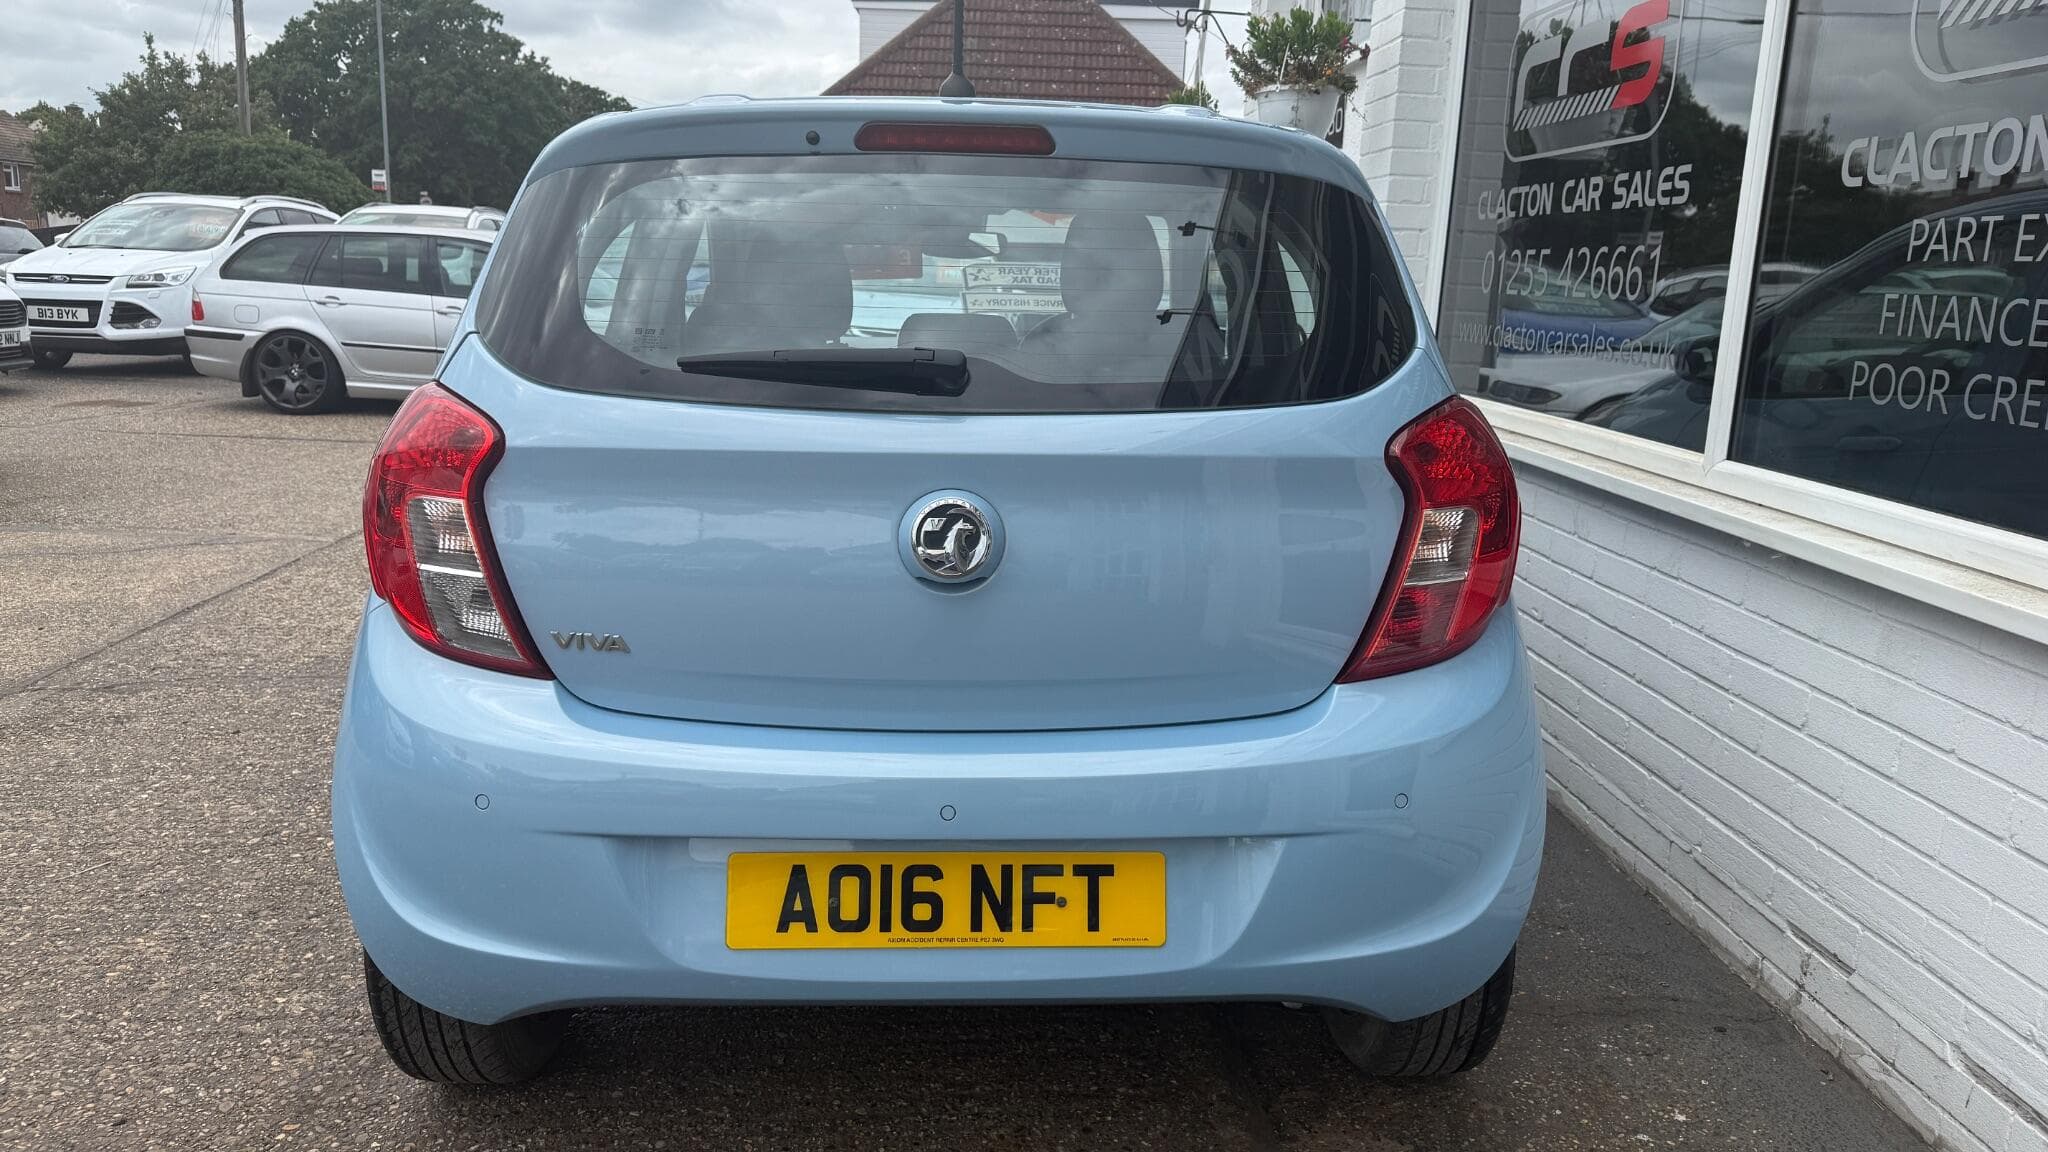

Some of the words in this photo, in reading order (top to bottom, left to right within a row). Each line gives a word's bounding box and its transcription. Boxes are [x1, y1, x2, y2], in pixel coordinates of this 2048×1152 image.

[1841, 114, 2048, 188] CLACTON
[1478, 182, 1555, 220] CLACTON
[1561, 176, 1604, 213] CAR
[1612, 163, 1693, 210] SALES
[1906, 215, 2004, 262] PART
[1481, 248, 1551, 297] 01255
[1556, 244, 1662, 304] 426661
[37, 307, 54, 319] B13
[57, 308, 79, 320] BYK
[1458, 312, 1676, 371] www.clactoncarsales.co.uk
[1879, 293, 2048, 348] FINANCE
[1849, 360, 1950, 415] POOR
[550, 630, 631, 654] VIVA
[970, 863, 1115, 934] NFT
